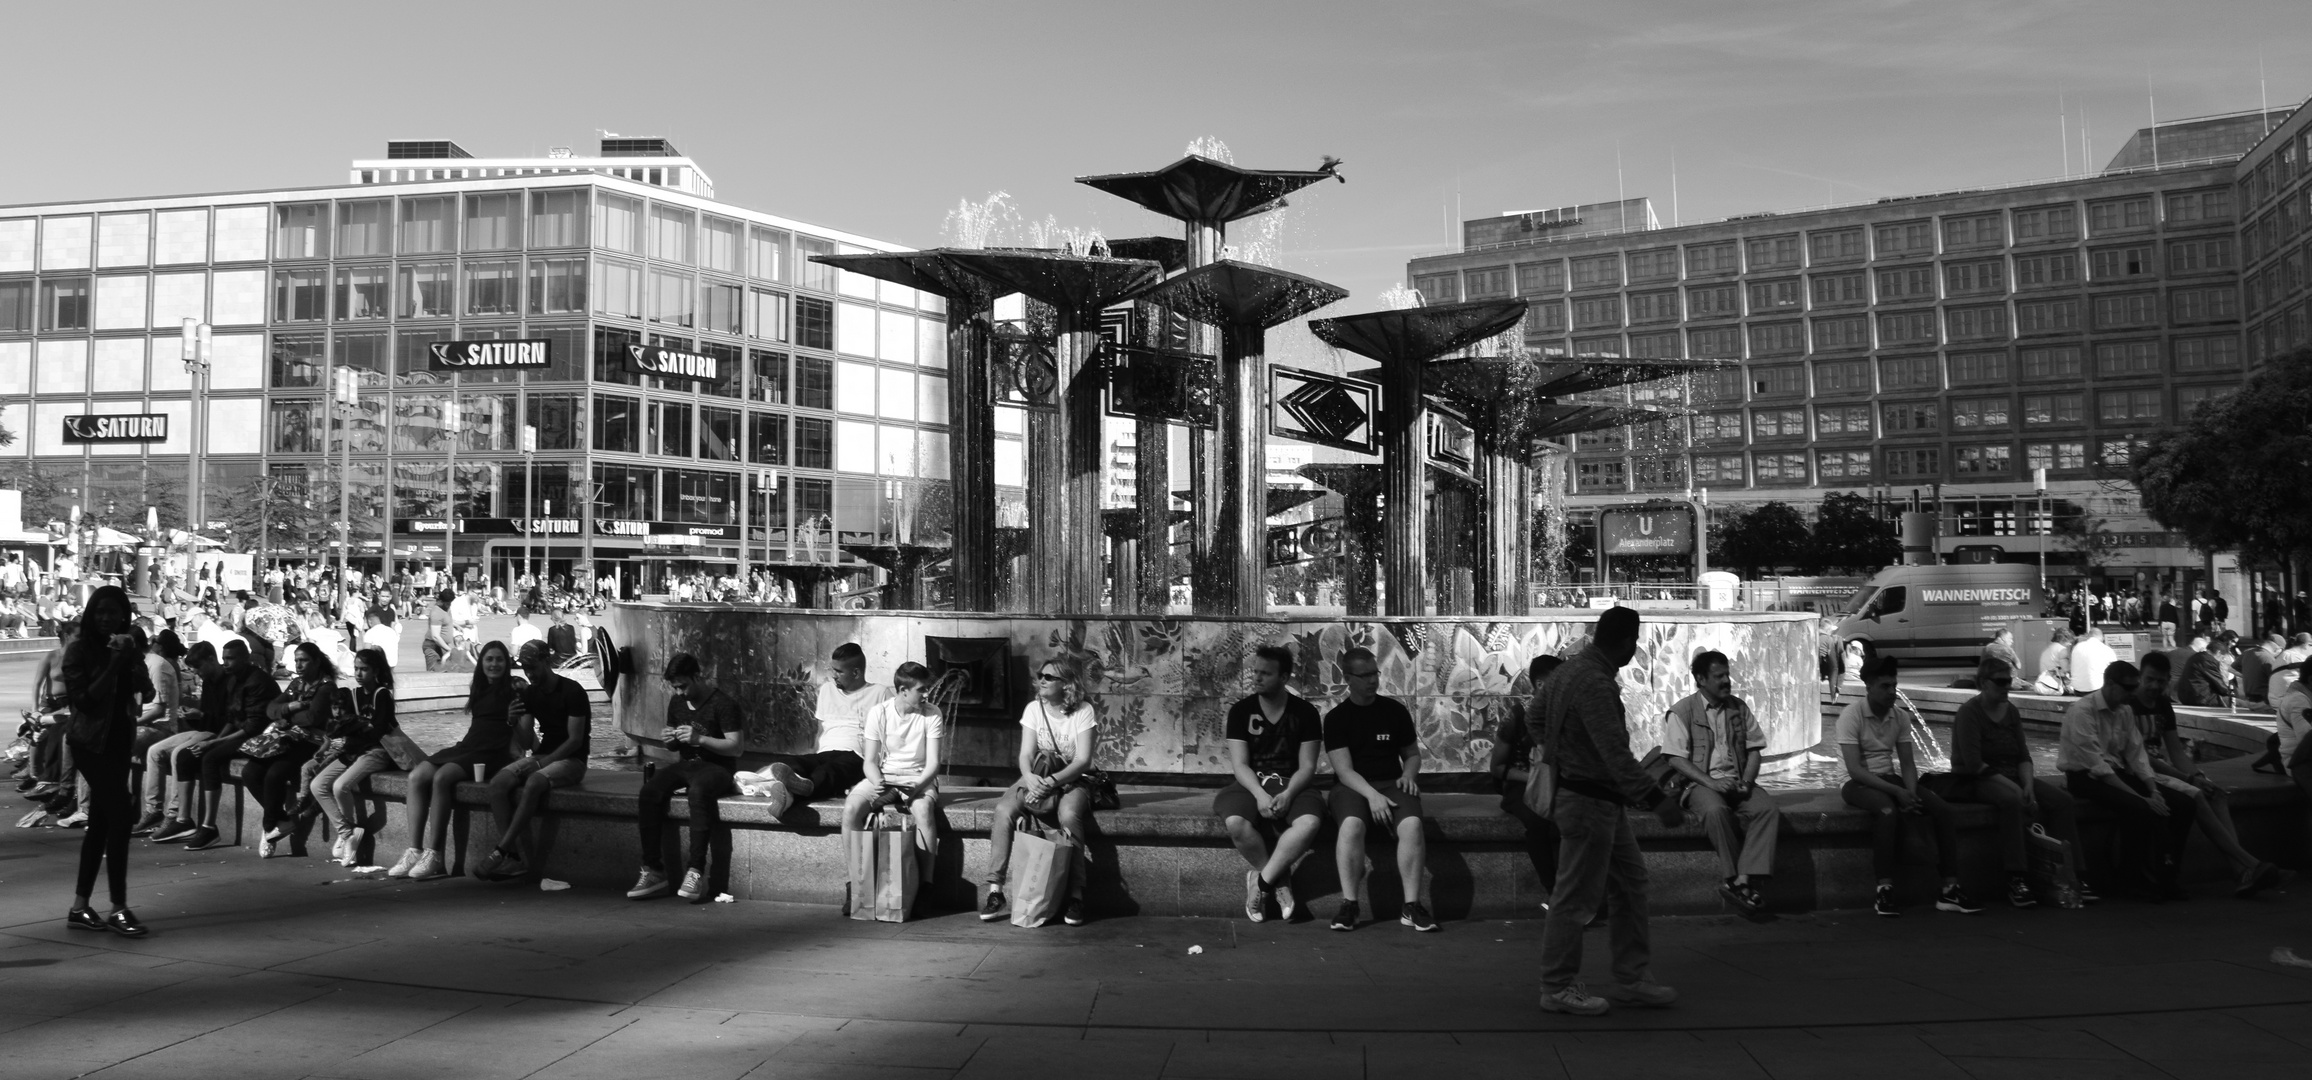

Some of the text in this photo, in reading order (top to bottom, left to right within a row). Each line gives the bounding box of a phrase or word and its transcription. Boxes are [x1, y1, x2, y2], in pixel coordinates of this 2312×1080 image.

[467, 342, 546, 365] SATURN
[658, 351, 716, 379] SATURN
[97, 417, 166, 438] SATURN
[532, 519, 580, 533] SATURN
[613, 521, 650, 536] SATURN
[689, 527, 724, 536] promod
[1640, 516, 1653, 535] U
[1619, 537, 1675, 549] Alexanderplatz
[1972, 551, 1982, 562] U
[1922, 588, 2031, 602] WANNENWETSCH
[1247, 713, 1265, 736] C
